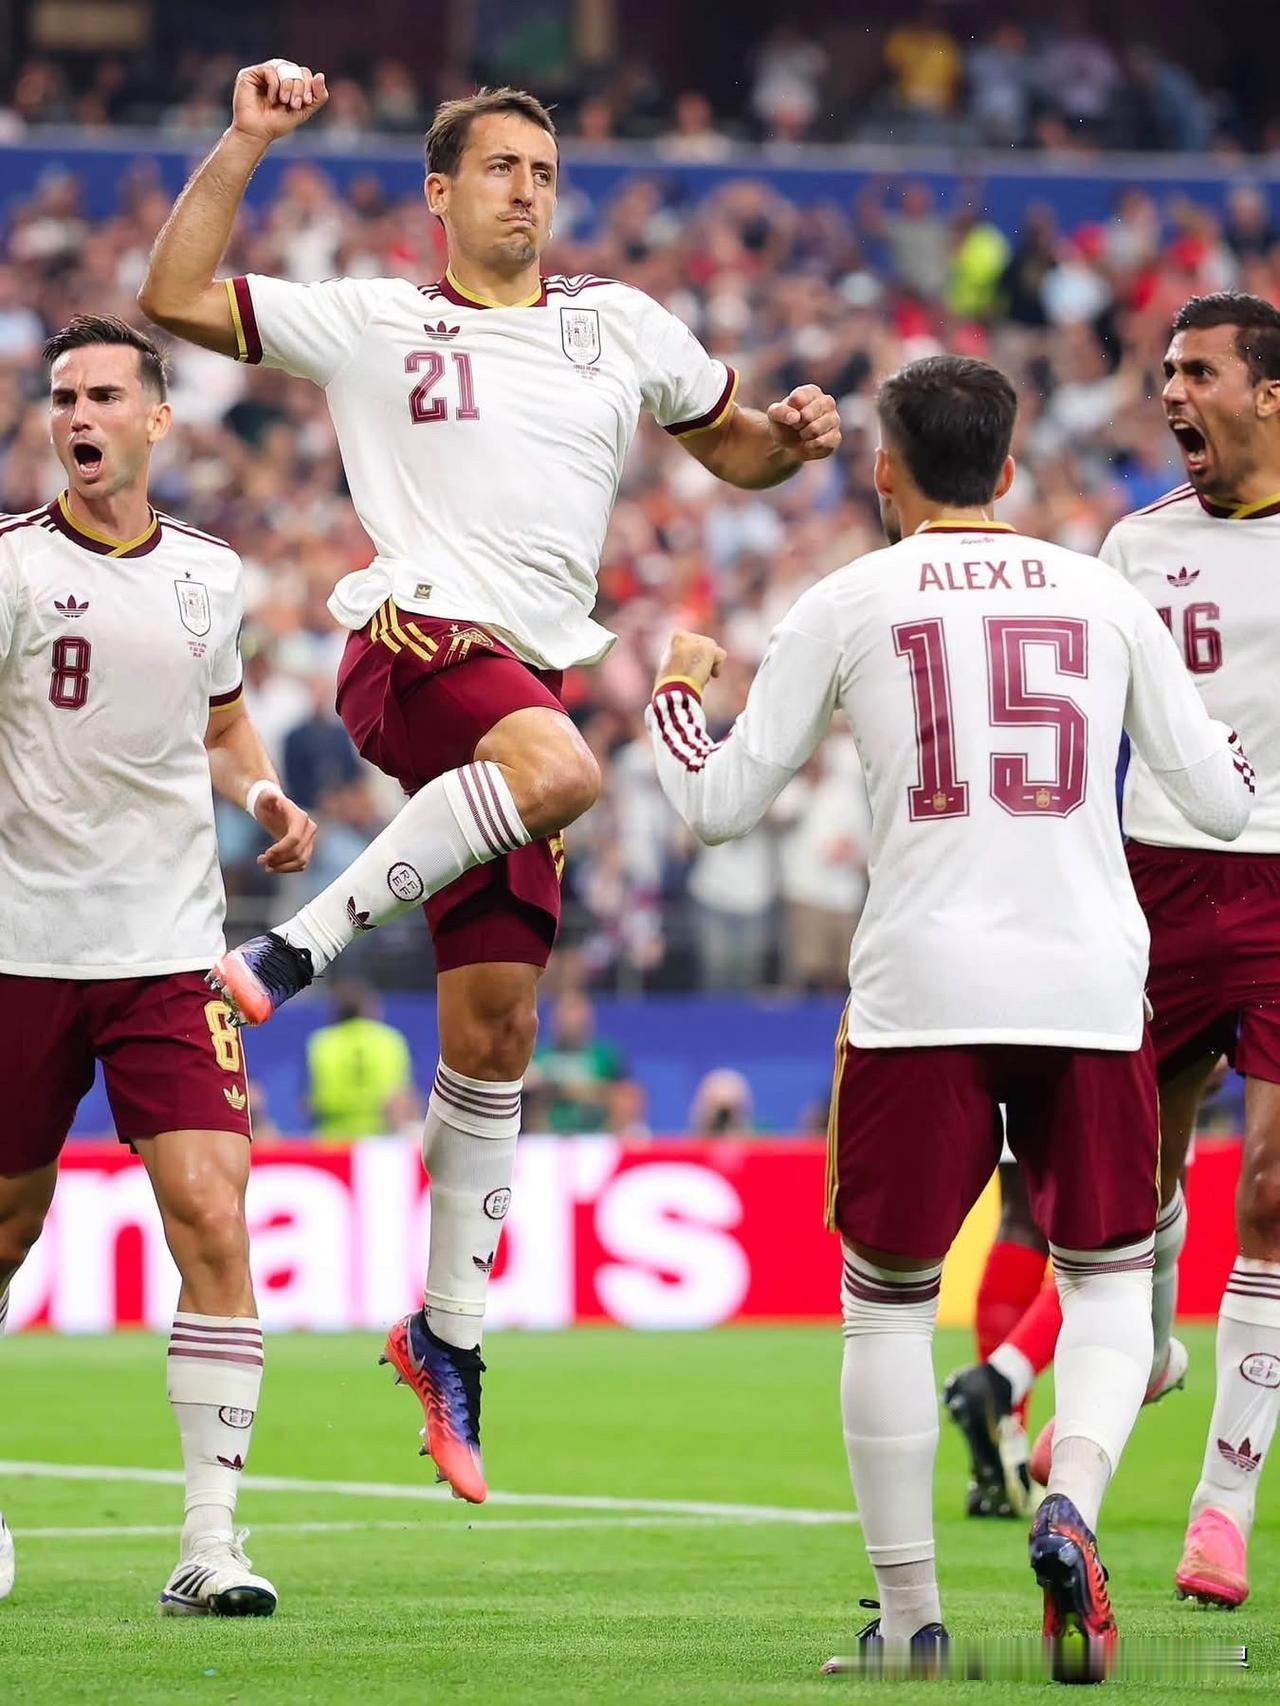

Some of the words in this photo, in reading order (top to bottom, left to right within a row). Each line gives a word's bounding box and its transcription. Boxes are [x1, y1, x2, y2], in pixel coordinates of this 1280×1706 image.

[404, 350, 480, 424] 21
[919, 561, 1012, 591] ALEX
[1022, 559, 1056, 588] B.
[48, 635, 91, 711] 8
[1156, 602, 1222, 674] 6
[892, 616, 1087, 822] 15
[204, 1000, 239, 1072] 8
